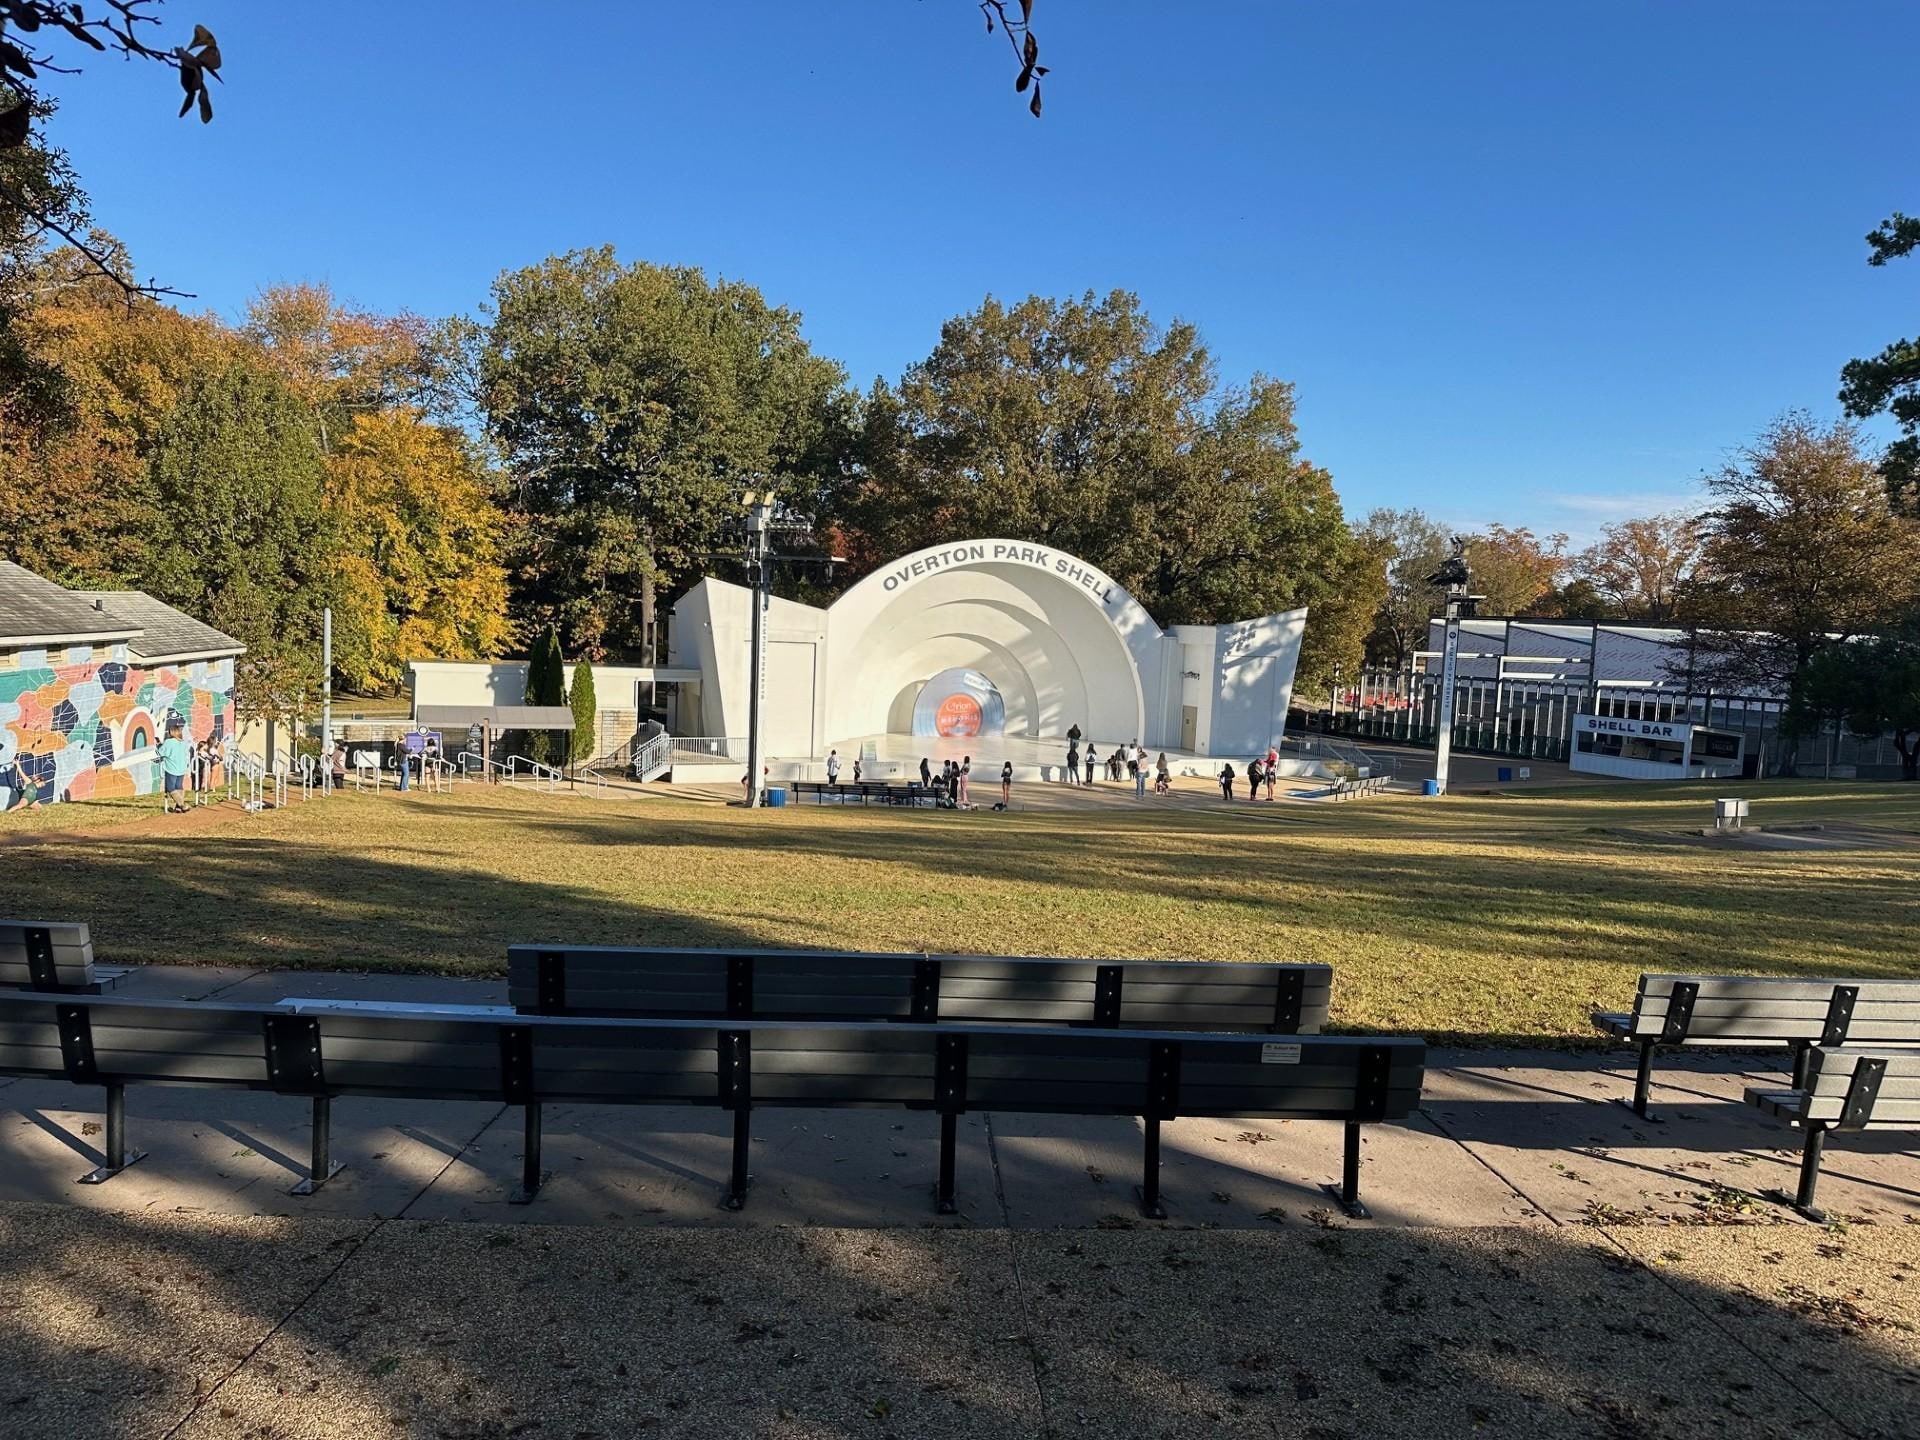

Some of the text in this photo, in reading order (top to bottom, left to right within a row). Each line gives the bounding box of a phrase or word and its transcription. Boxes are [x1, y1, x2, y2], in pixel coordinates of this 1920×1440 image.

[882, 545, 1112, 604] OVERTON PARK SHELL
[1588, 719, 1673, 737] SHELL BAR
